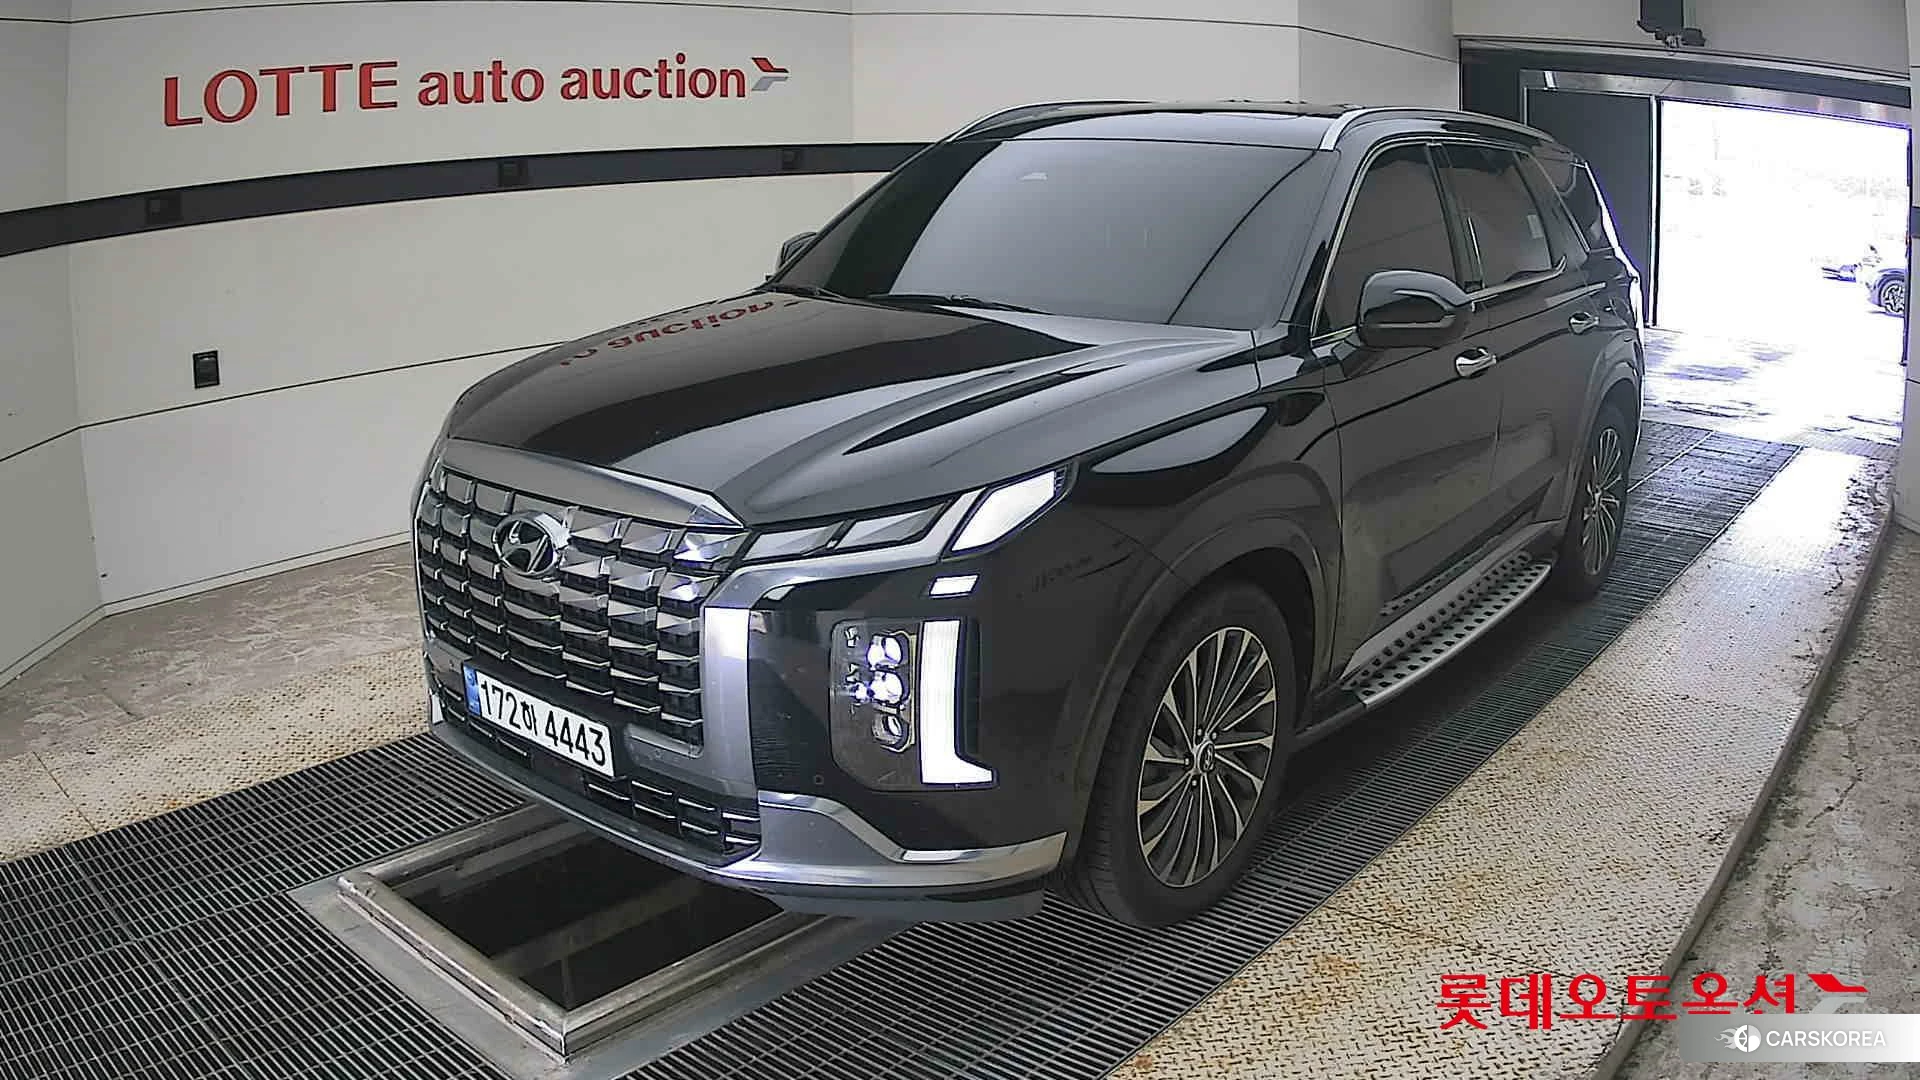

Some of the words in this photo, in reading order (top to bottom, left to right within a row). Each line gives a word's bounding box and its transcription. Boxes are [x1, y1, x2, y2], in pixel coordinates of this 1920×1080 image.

[163, 60, 399, 127] LOTTE
[418, 59, 546, 107] auto
[559, 52, 747, 100] auction
[480, 680, 538, 737] 172하
[544, 710, 606, 767] 4443
